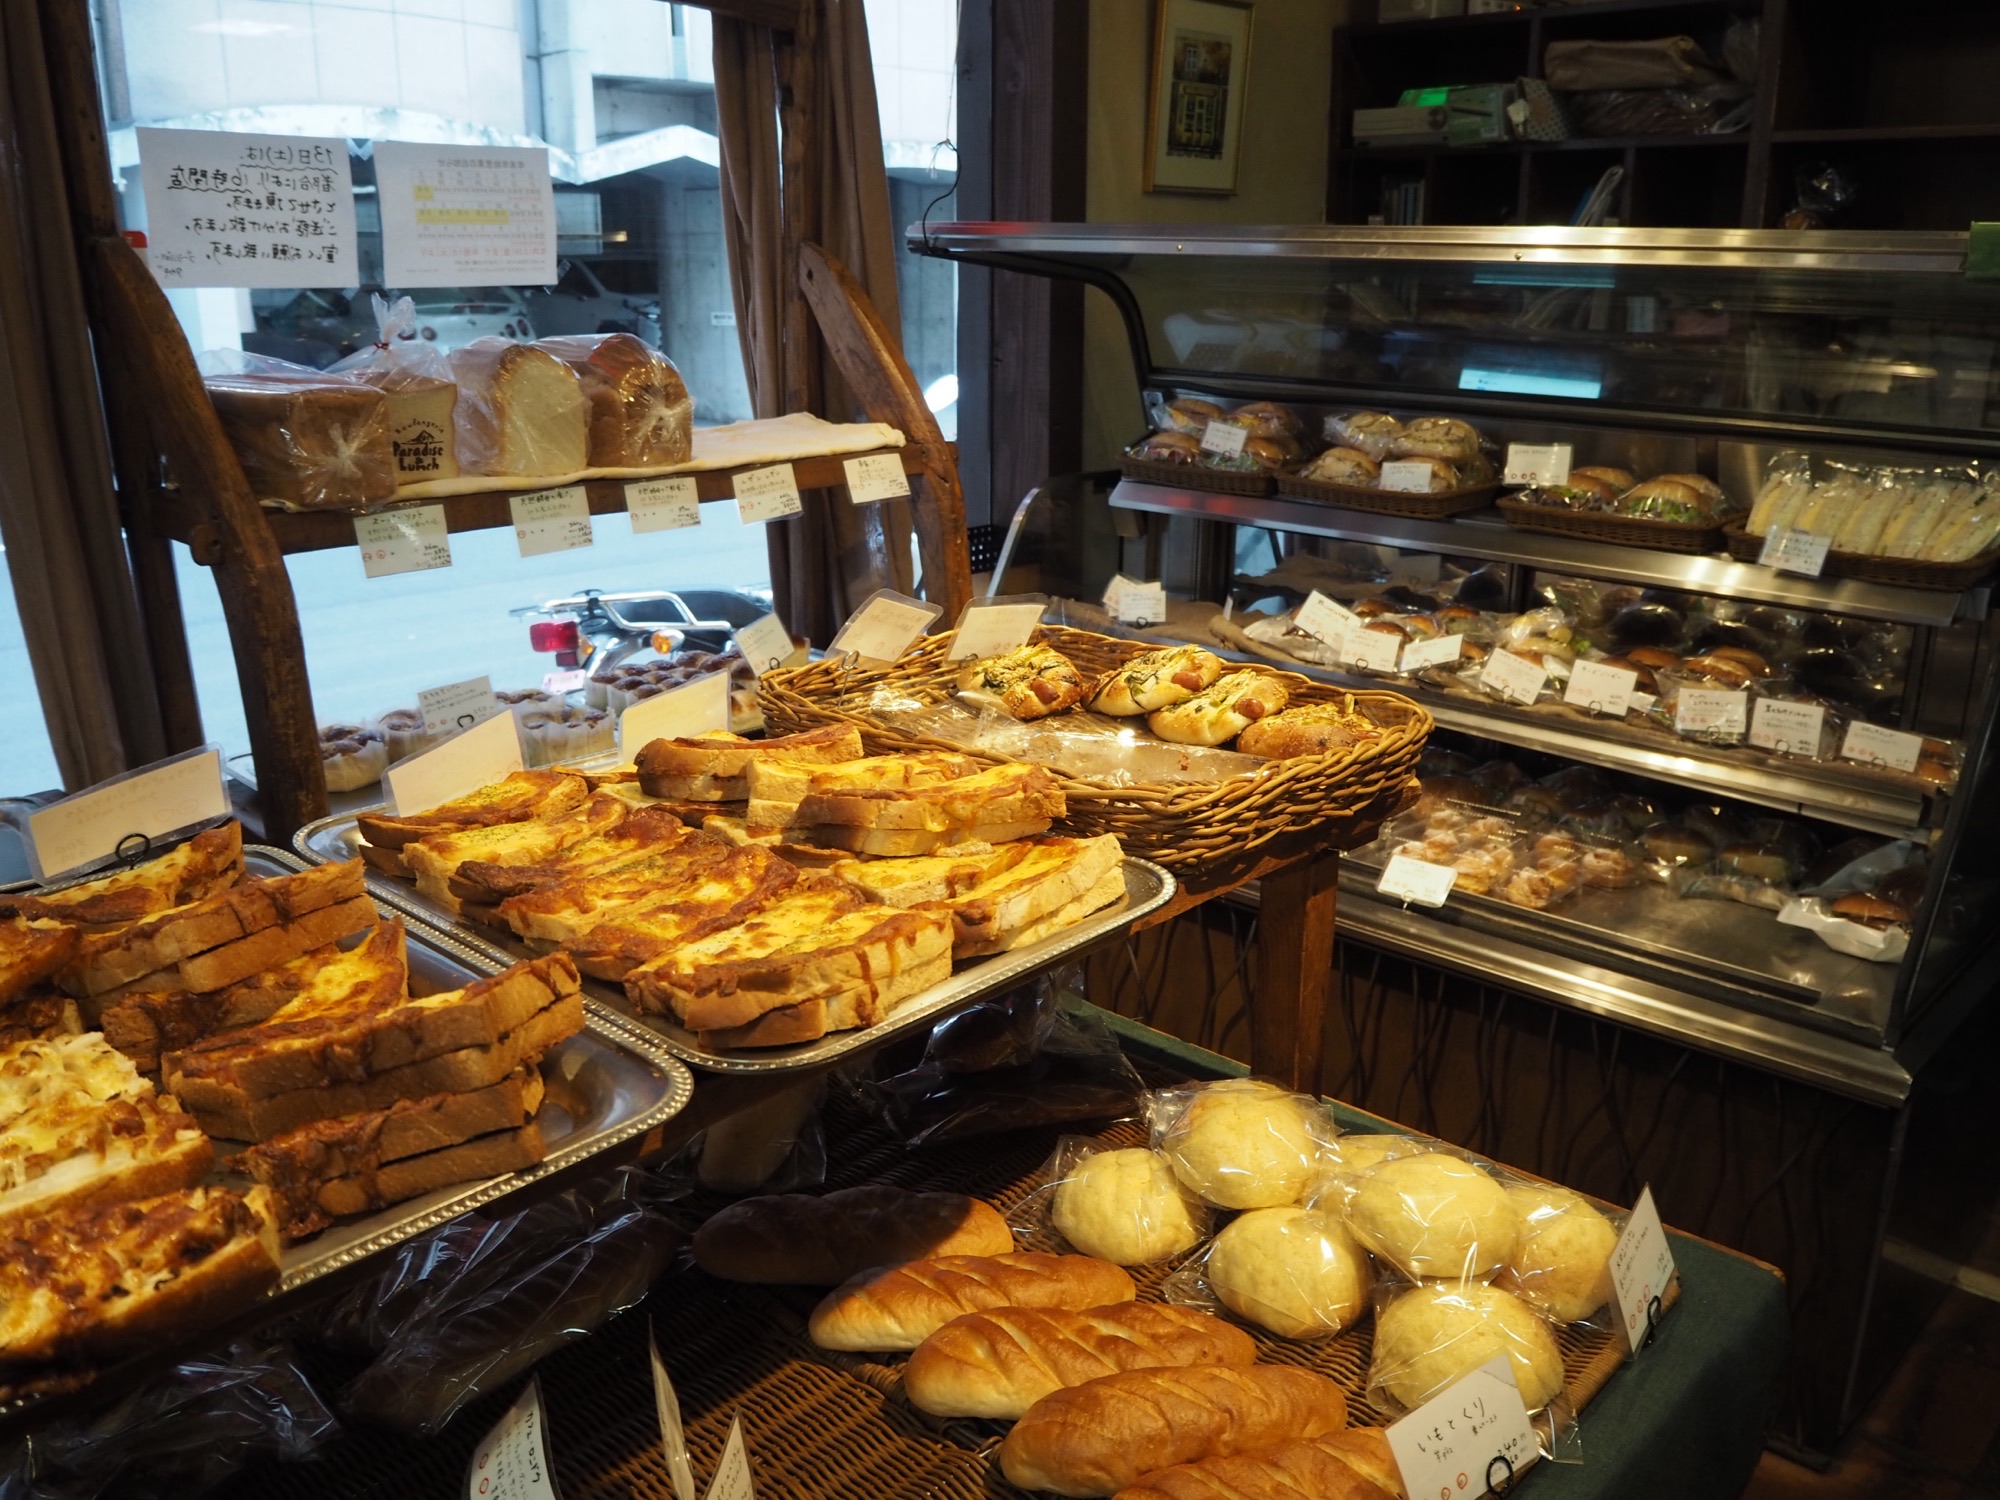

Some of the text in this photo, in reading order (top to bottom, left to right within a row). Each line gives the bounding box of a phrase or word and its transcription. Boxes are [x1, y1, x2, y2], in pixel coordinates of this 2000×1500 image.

[392, 441, 444, 457] Paradise
[399, 457, 440, 472] Lunch
[1417, 1396, 1485, 1452] いもとくり
